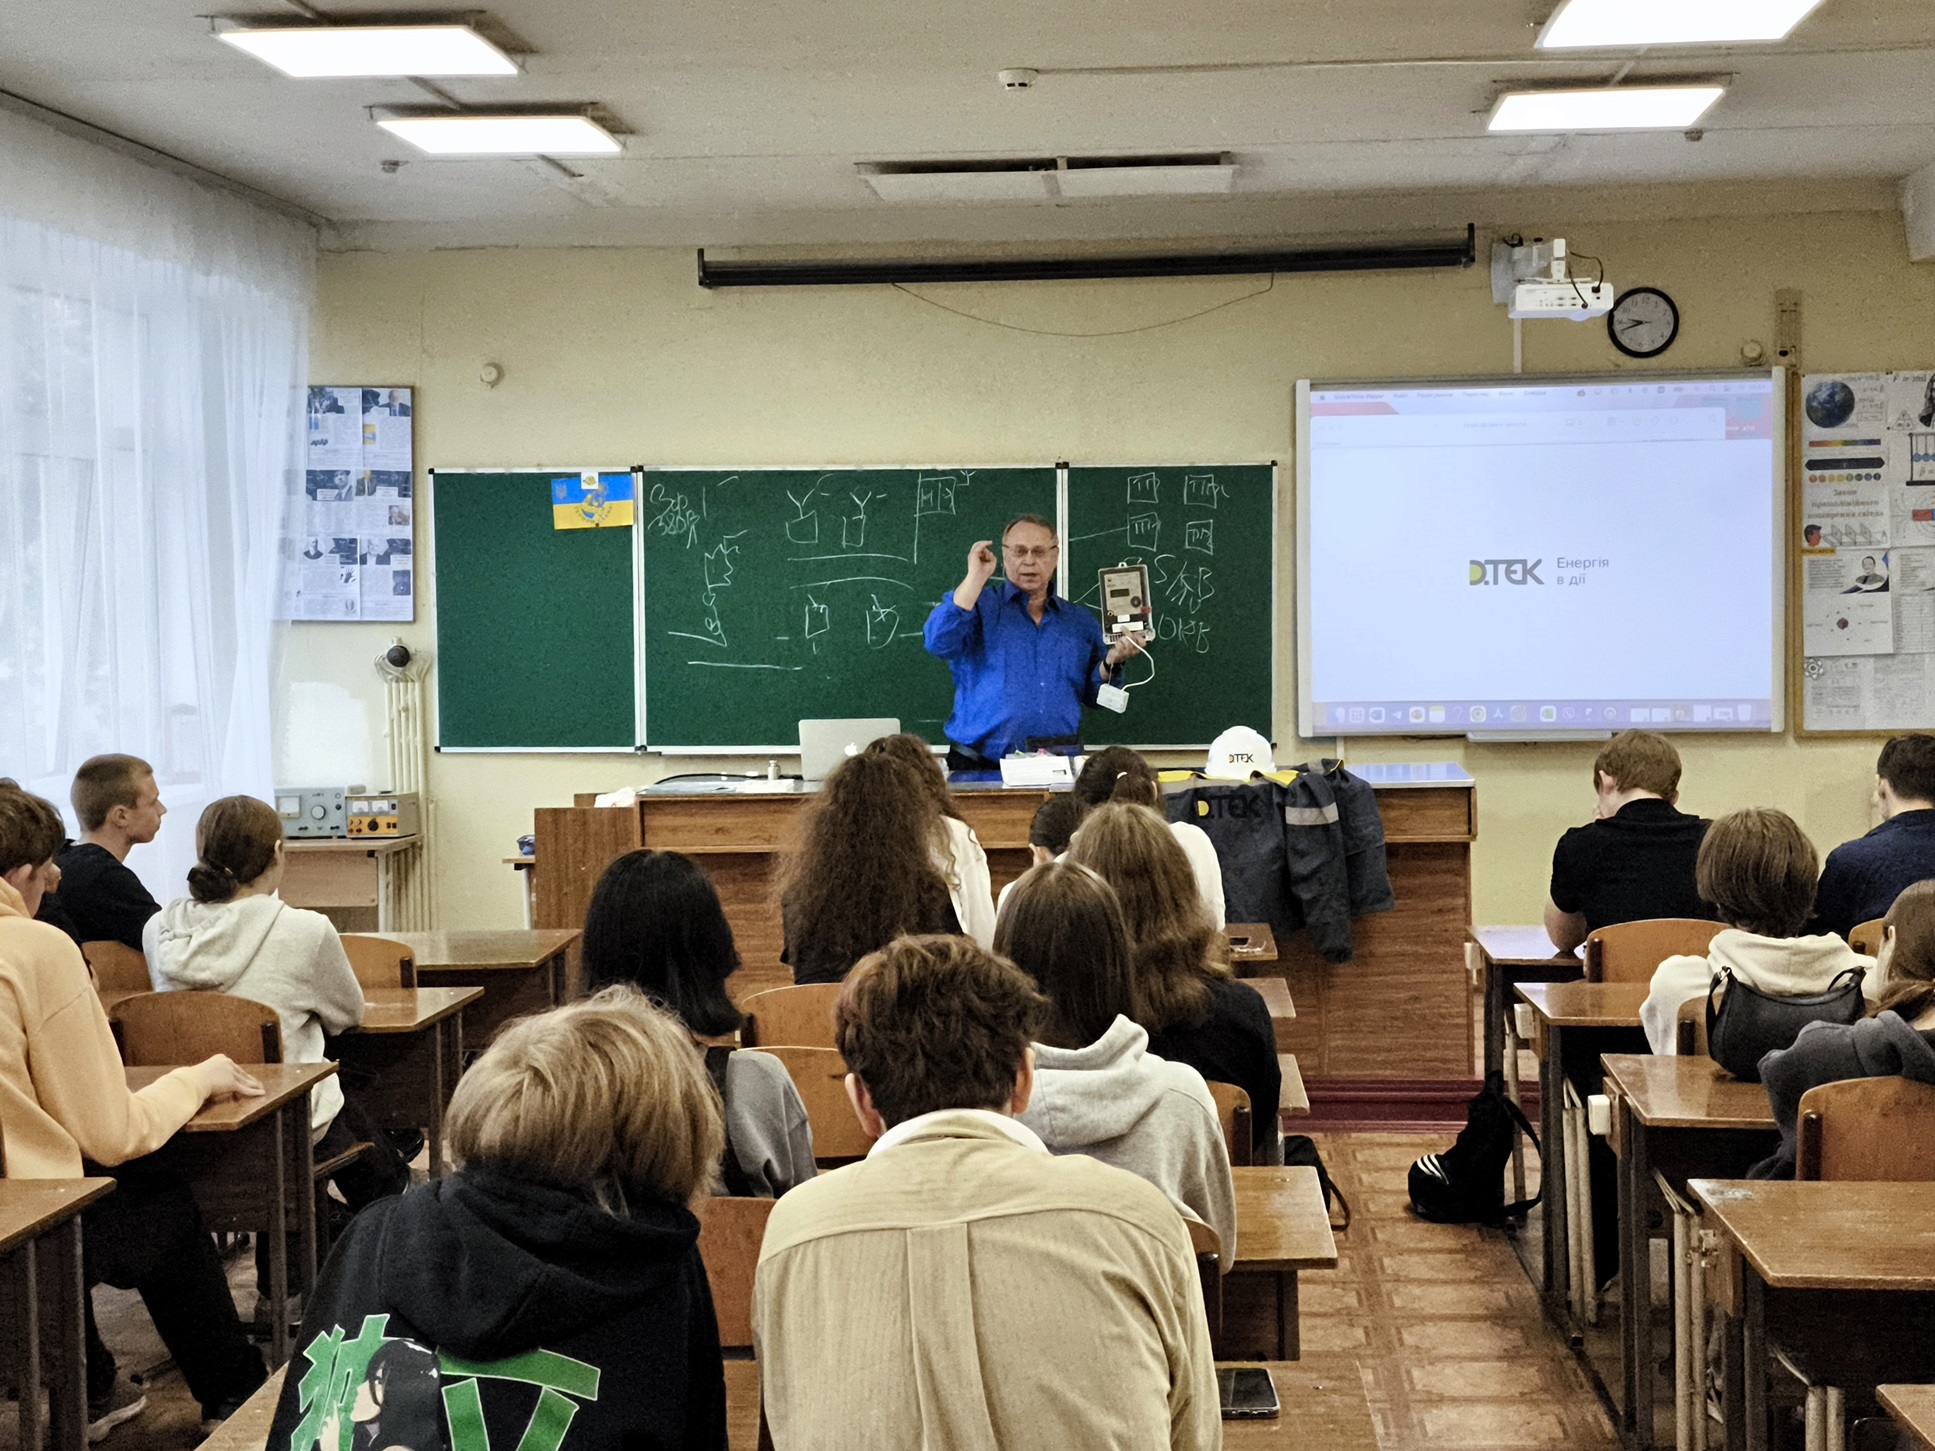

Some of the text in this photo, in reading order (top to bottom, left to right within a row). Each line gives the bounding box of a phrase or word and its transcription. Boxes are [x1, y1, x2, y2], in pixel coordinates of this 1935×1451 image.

[1556, 556, 1610, 571] Енергія
[1556, 573, 1586, 586] в дії
